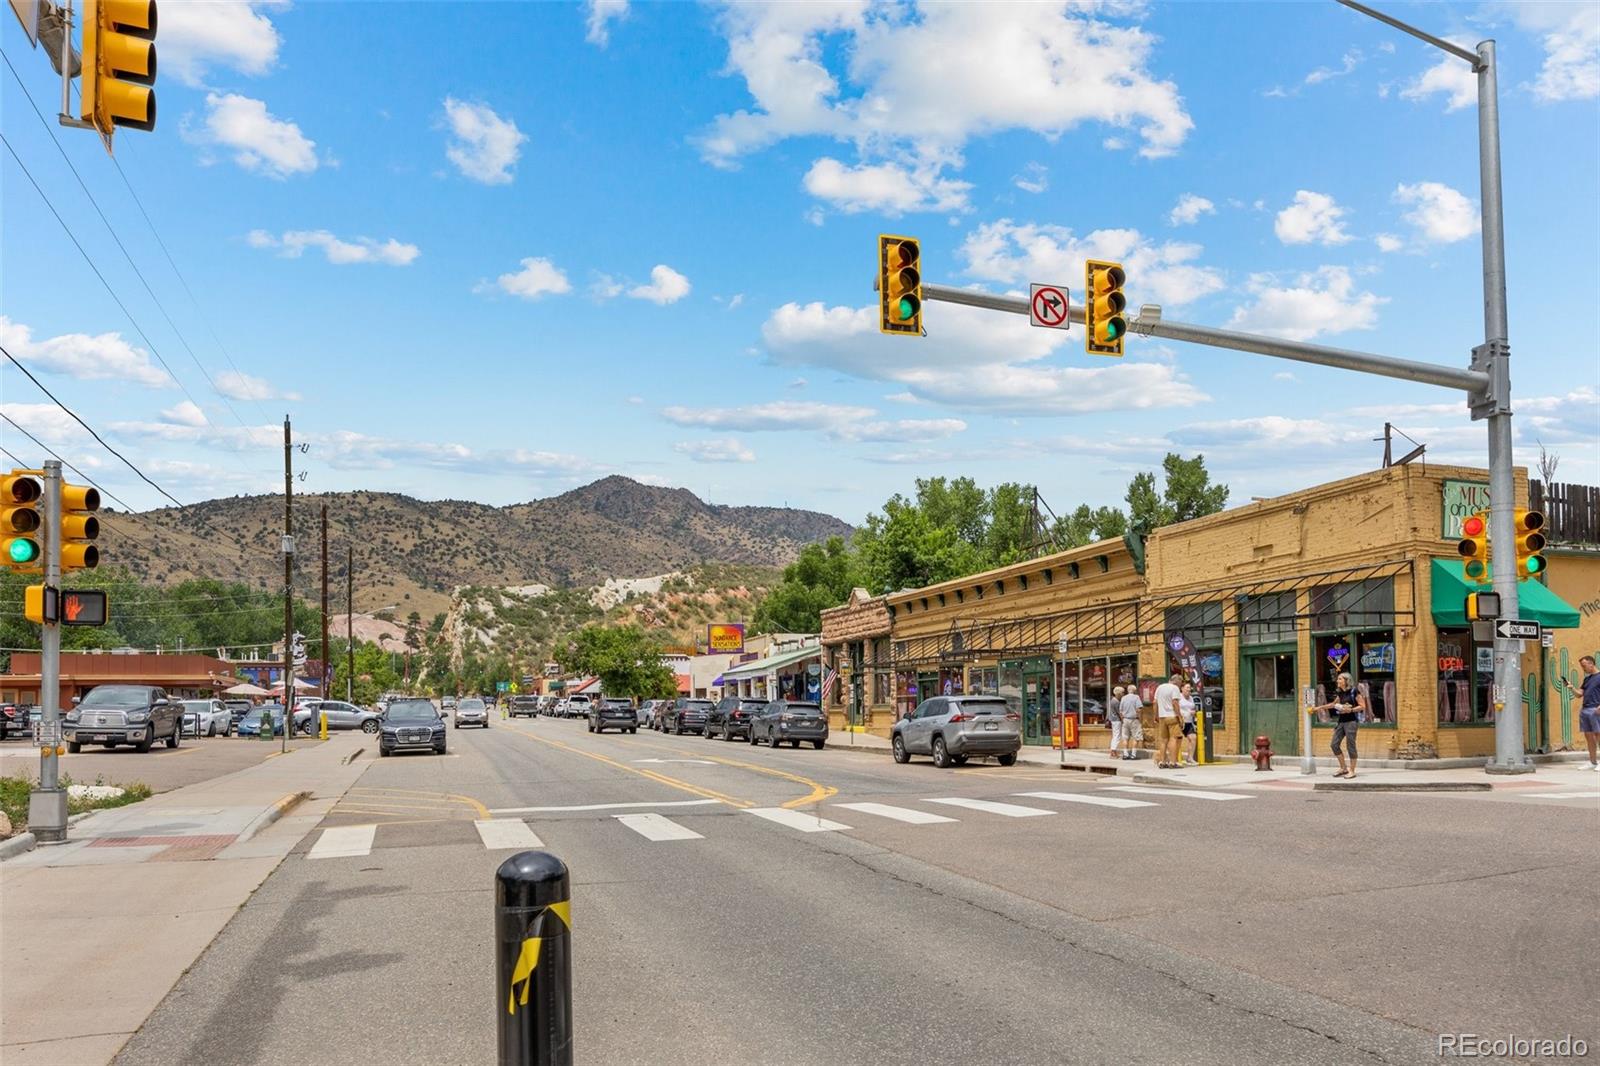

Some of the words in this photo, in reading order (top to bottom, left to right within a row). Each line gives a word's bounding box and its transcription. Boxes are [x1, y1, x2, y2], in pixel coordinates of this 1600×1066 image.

[1510, 625, 1520, 633] ONE
[1523, 626, 1536, 634] WAY
[1439, 656, 1464, 671] OPEN
